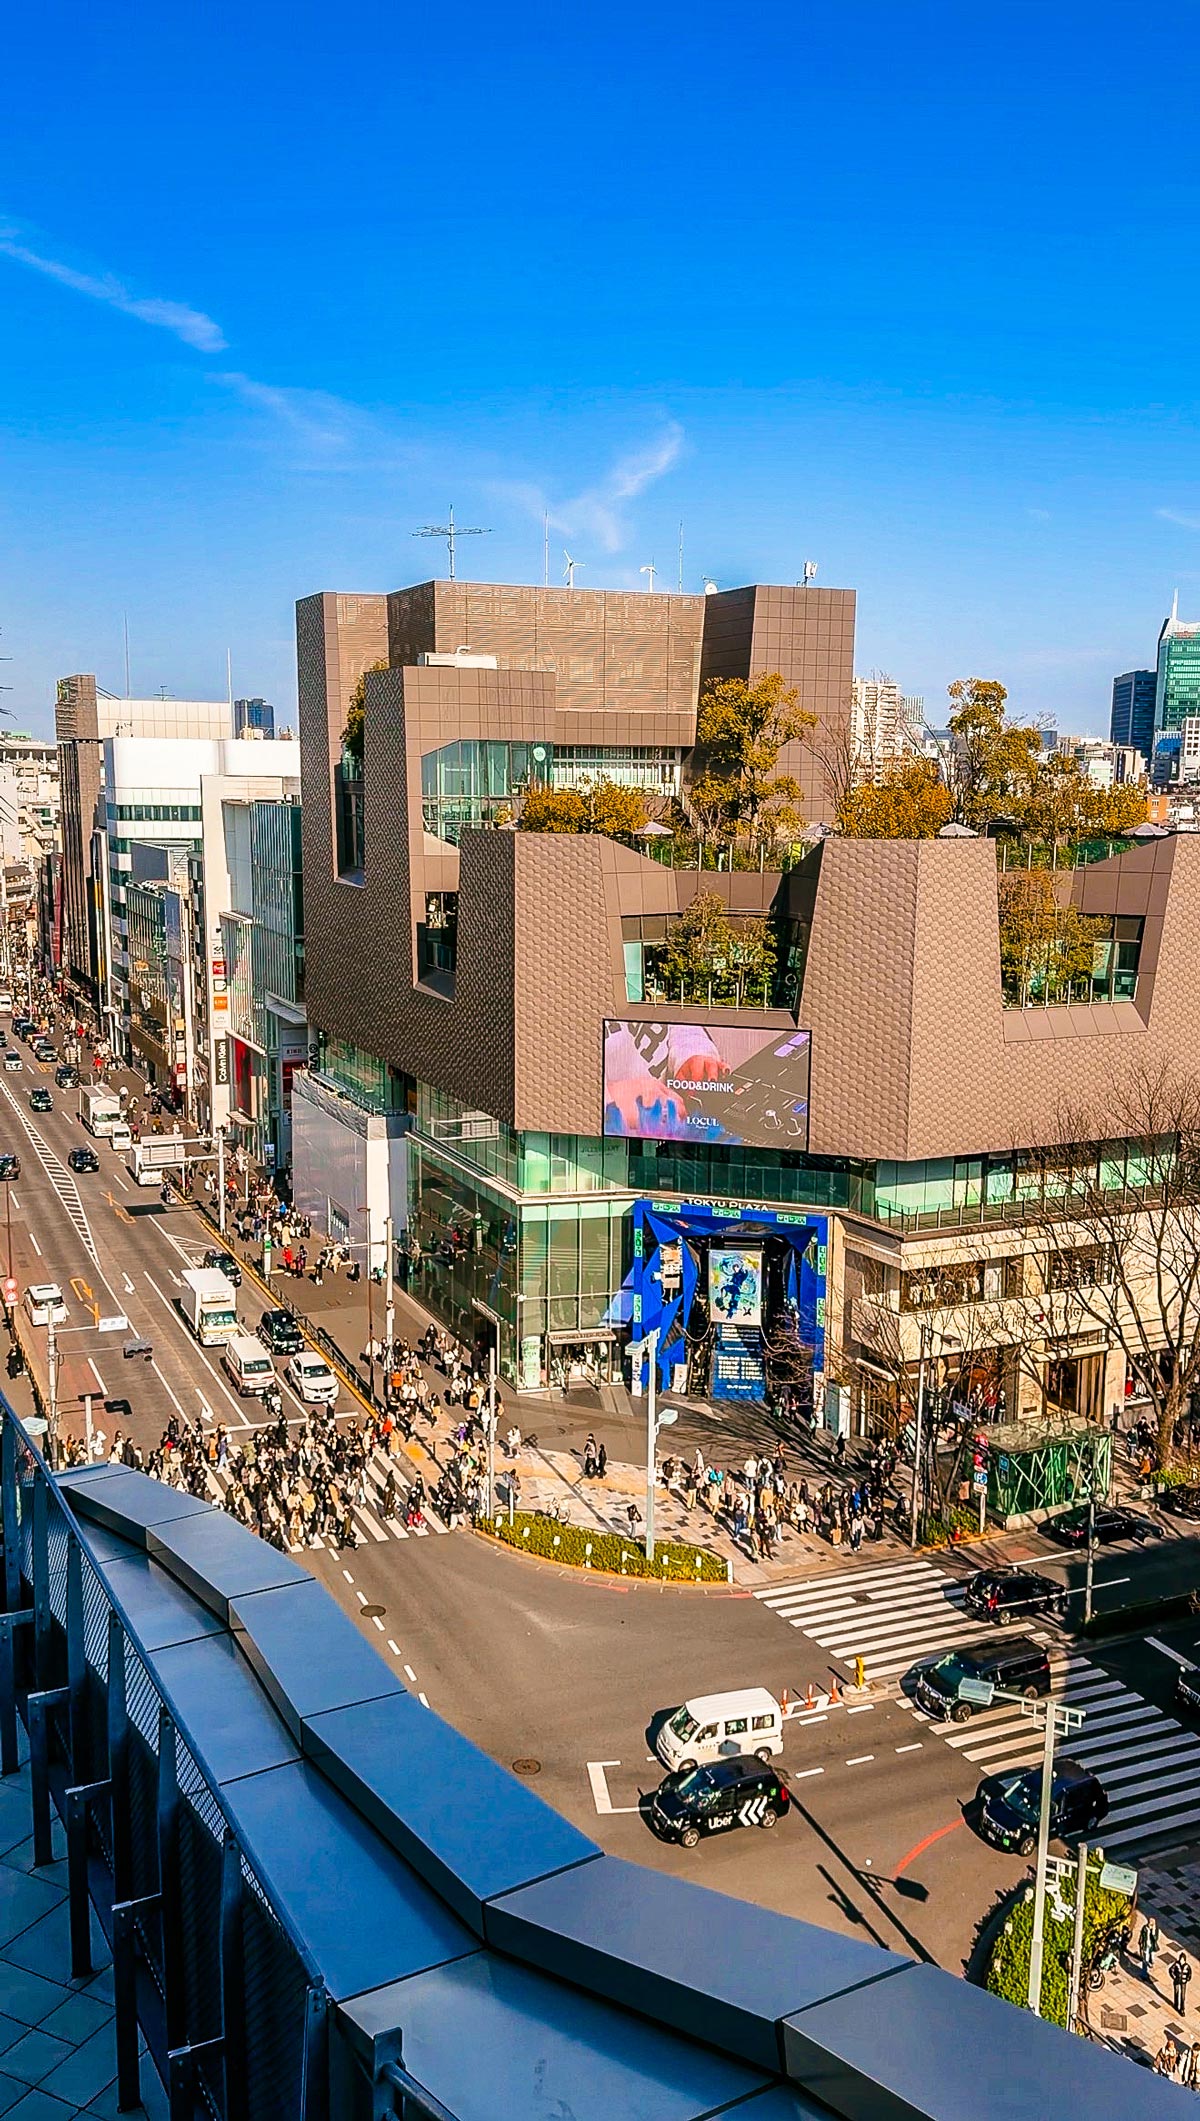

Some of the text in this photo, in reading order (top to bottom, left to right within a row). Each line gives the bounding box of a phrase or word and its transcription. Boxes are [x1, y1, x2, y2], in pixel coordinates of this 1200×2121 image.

[218, 1041, 227, 1082] Calvin Klein
[666, 1079, 734, 1093] FOOD&DRINK
[686, 1197, 726, 1208] TOKYU
[729, 1201, 769, 1211] PLAZA
[708, 1815, 733, 1830] Uber
